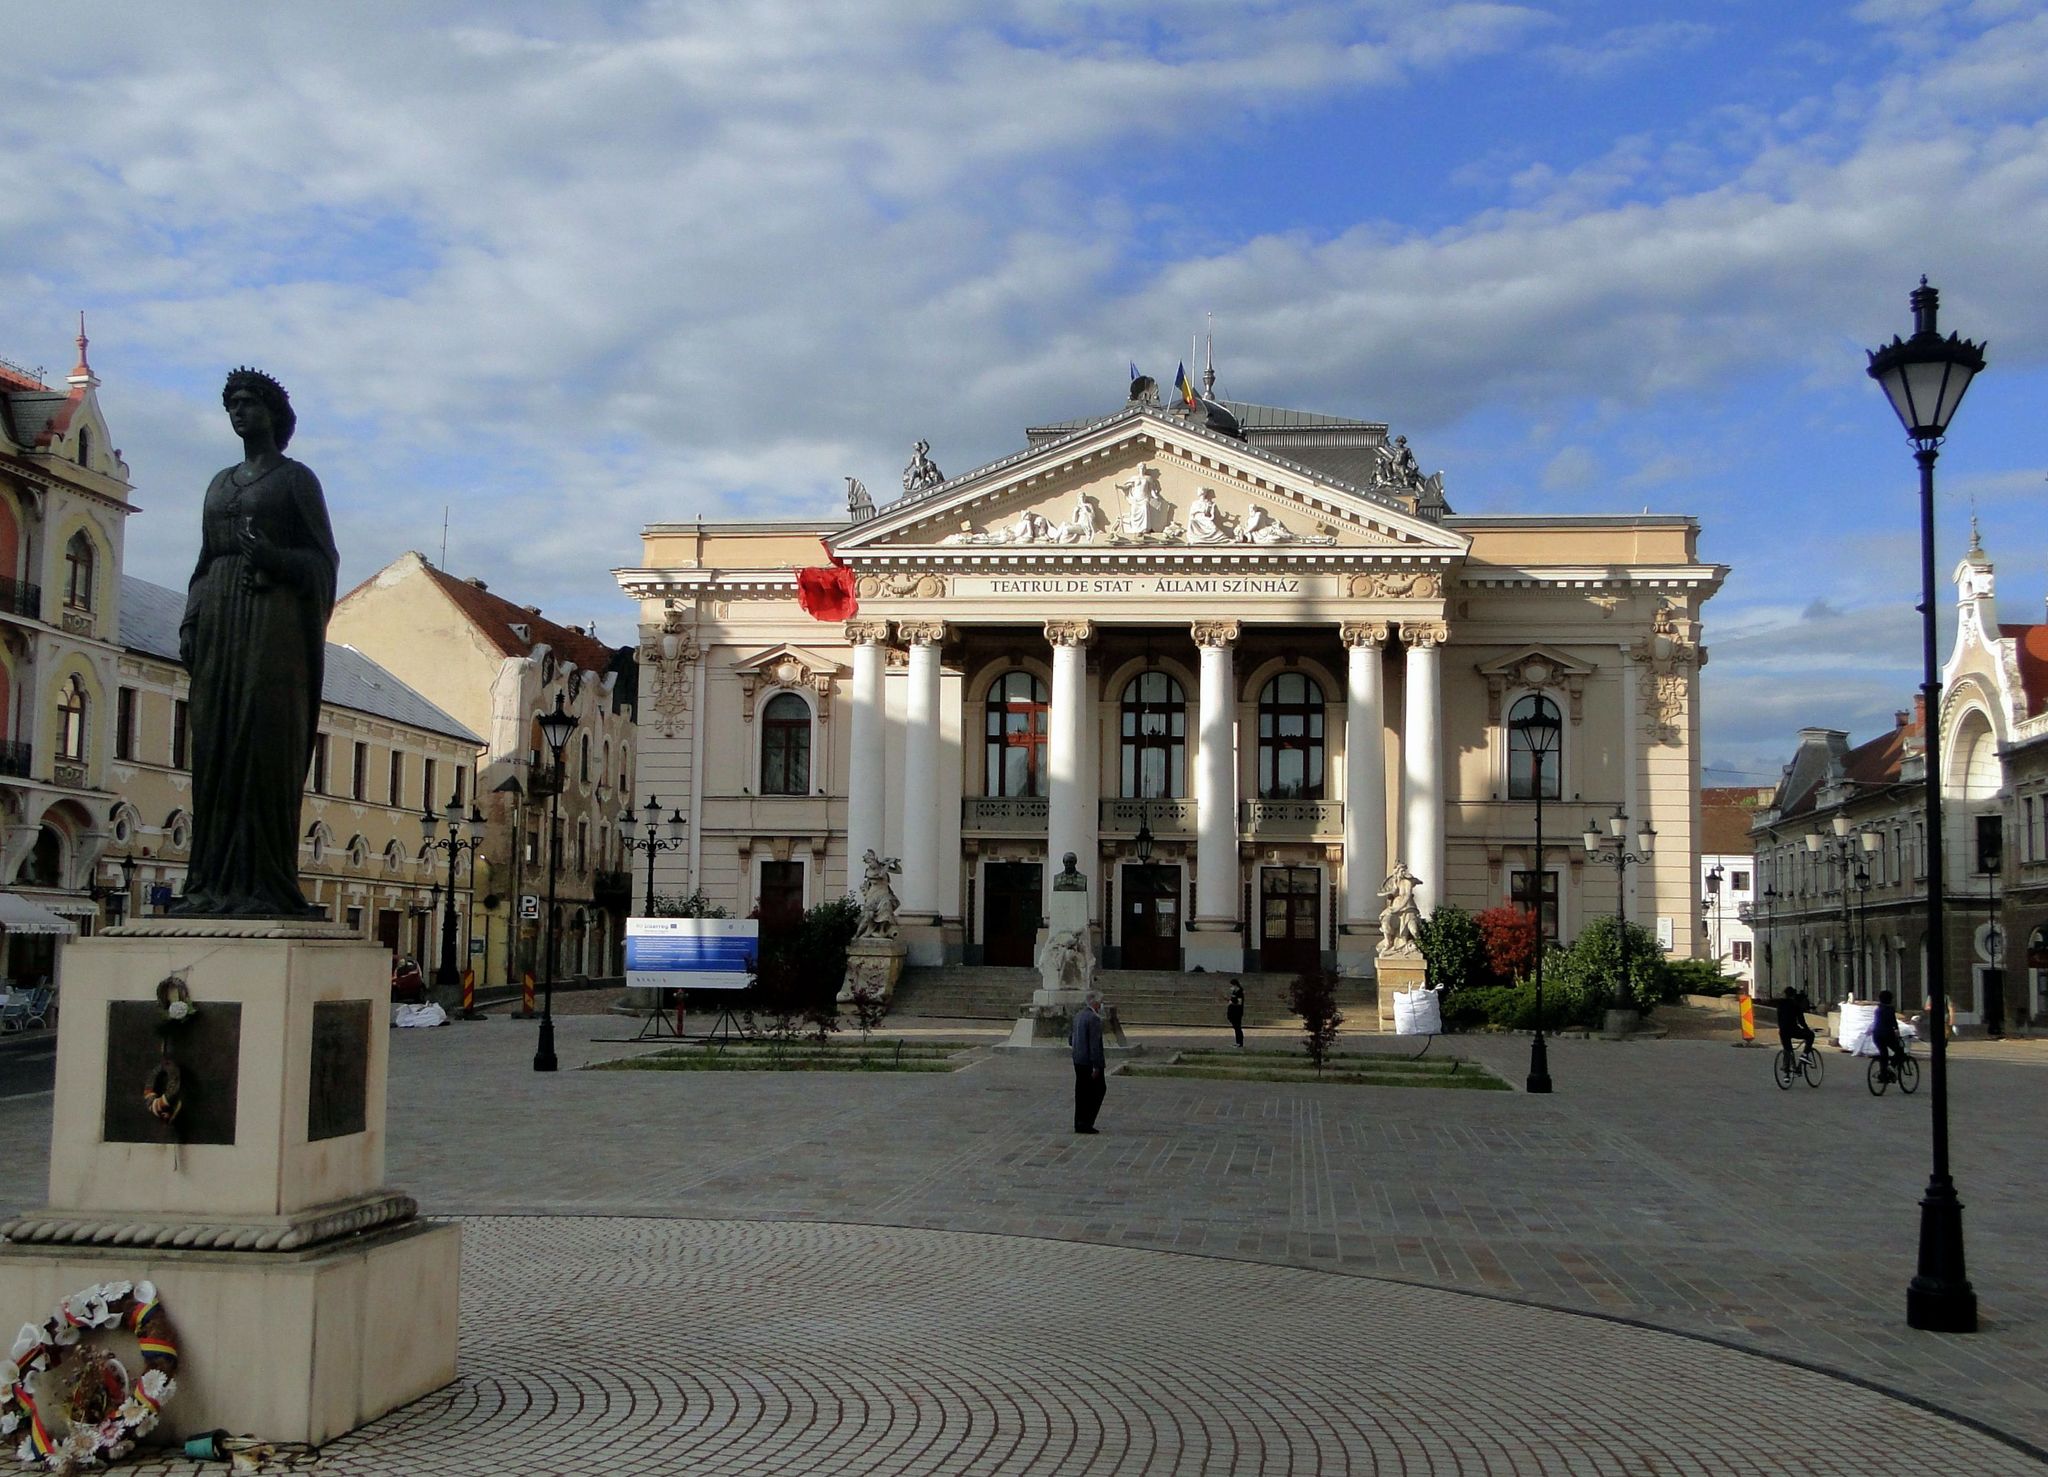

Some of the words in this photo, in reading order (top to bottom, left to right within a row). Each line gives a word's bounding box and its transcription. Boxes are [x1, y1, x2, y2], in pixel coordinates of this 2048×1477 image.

[990, 580, 1063, 593] TEATRUL
[1067, 580, 1089, 593] DE
[1093, 580, 1133, 593] STAT
[1155, 577, 1217, 593] ÁLLAMI
[1222, 576, 1299, 593] SZÍNHÁZ
[522, 895, 537, 912] P
